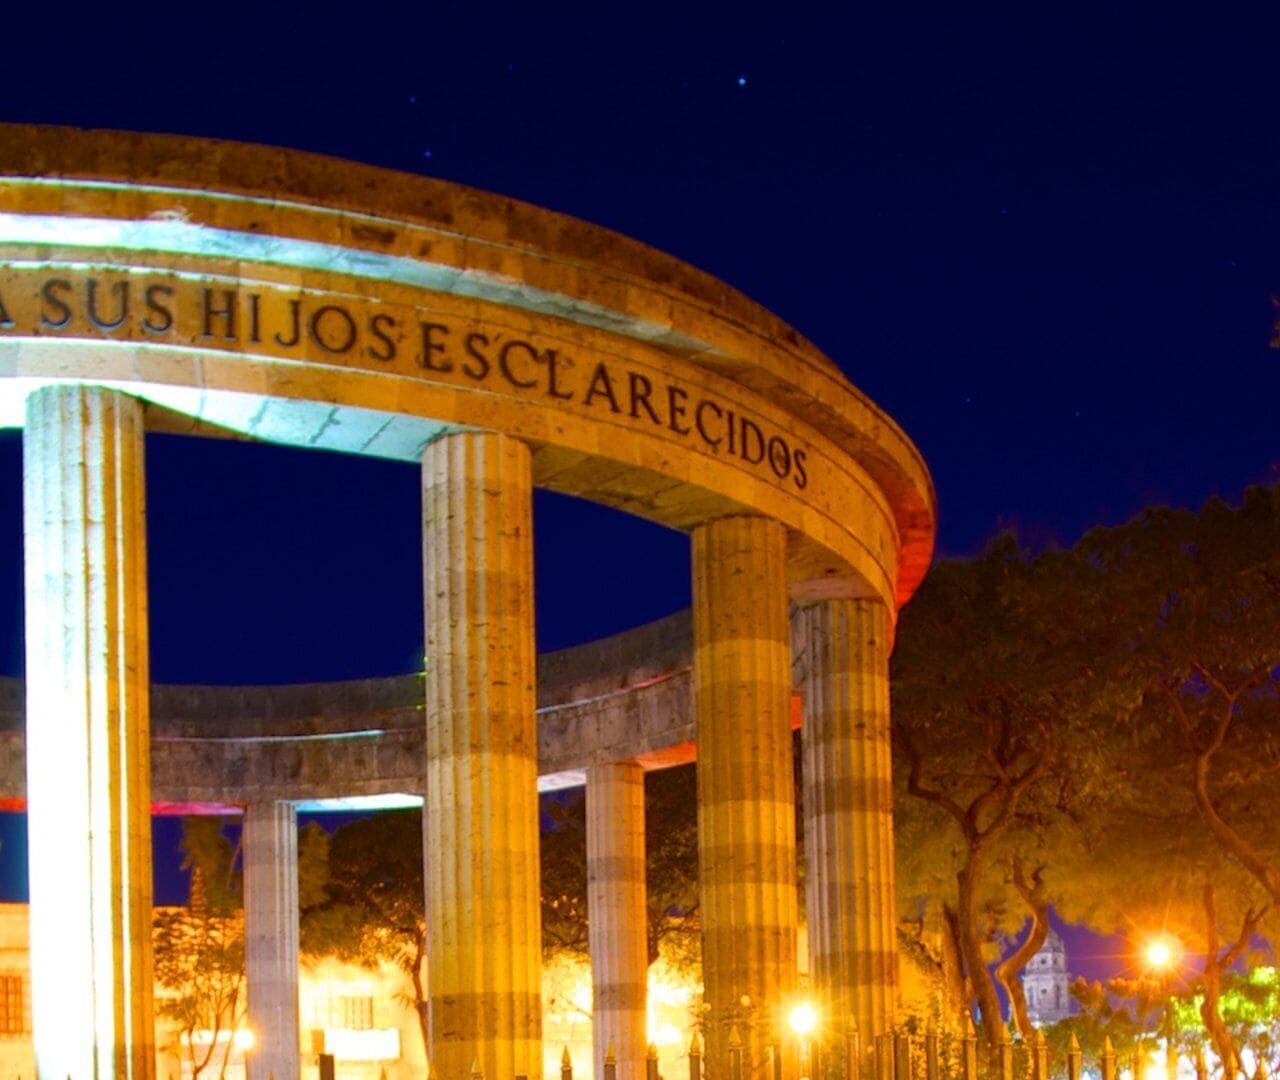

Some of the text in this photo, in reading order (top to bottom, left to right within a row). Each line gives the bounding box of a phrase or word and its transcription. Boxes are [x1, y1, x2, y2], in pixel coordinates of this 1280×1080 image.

[41, 280, 174, 333] SUS
[200, 287, 398, 362] HIJOS
[420, 322, 807, 489] ESCLARECIDOS
